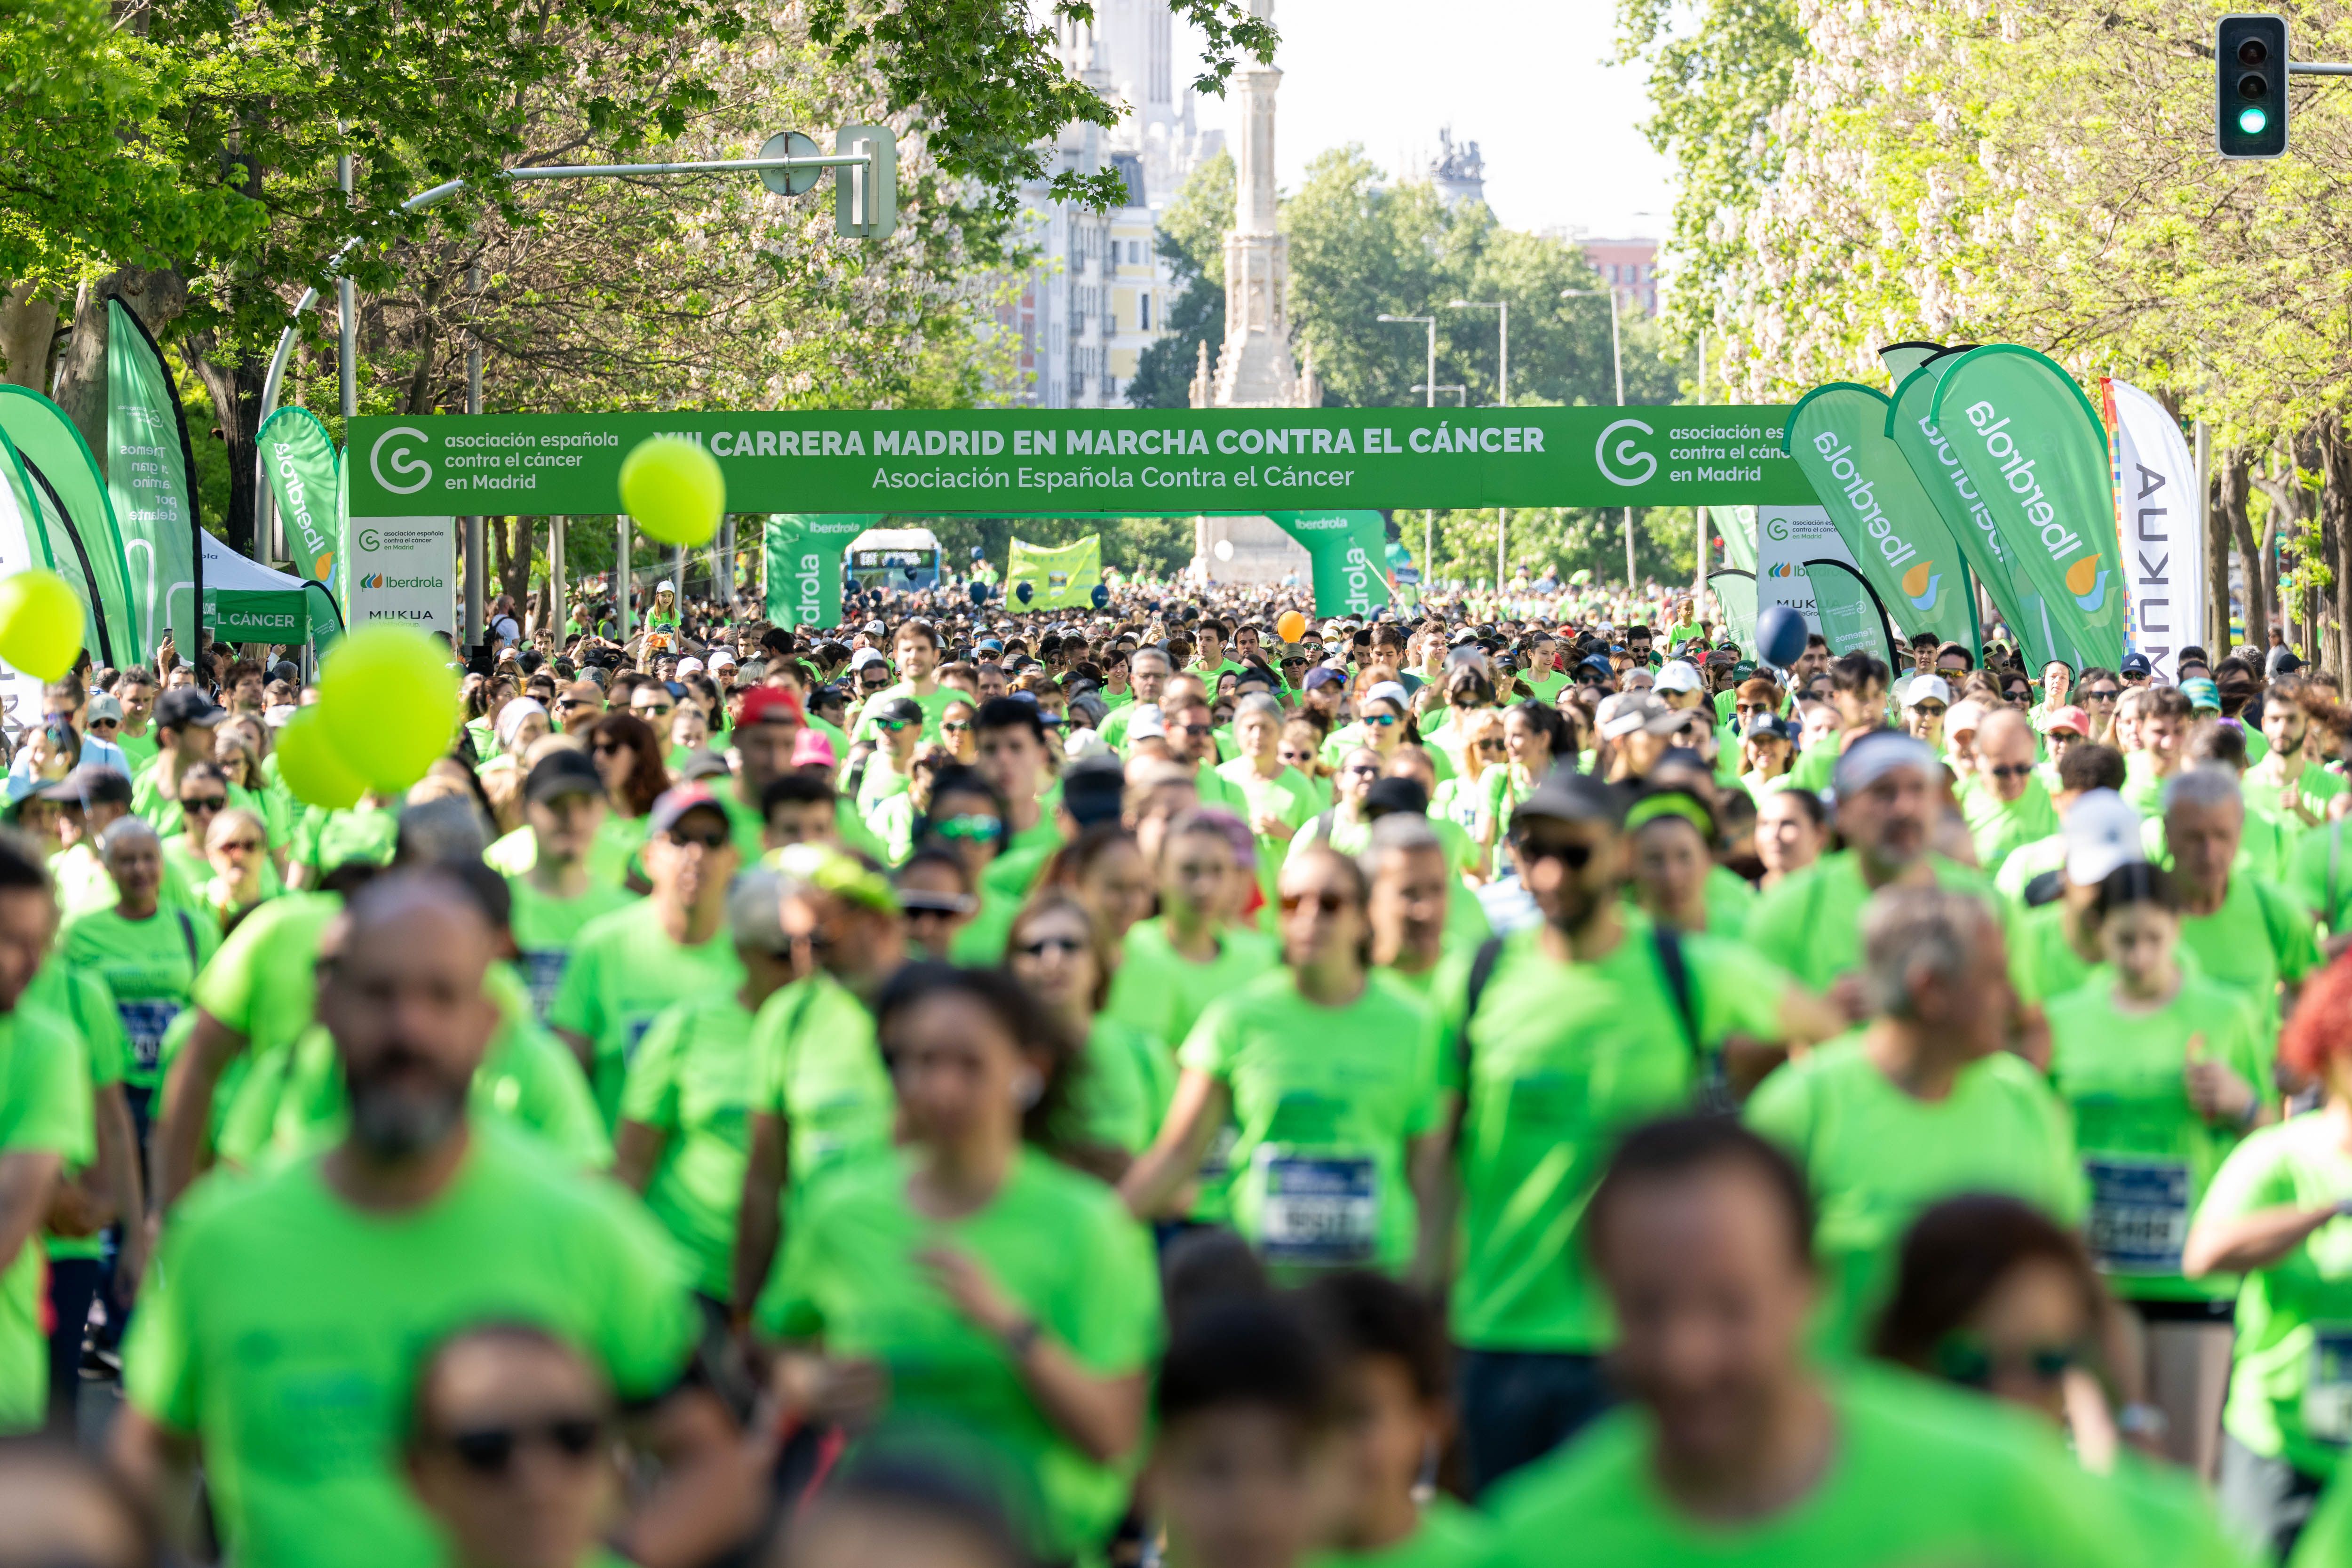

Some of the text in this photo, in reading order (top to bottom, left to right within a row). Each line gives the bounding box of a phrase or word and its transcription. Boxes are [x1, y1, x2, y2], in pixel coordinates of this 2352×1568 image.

[710, 431, 866, 456] CARRERA
[874, 430, 1004, 455] MADRID
[1014, 430, 1056, 455] EN
[1066, 429, 1209, 455] MARCHA
[1216, 428, 1356, 454] CONTRA
[1364, 428, 1402, 454] EL
[1409, 421, 1545, 453] CÁNCER
[1669, 424, 1761, 439] asociación
[445, 431, 618, 451] asociación española
[445, 452, 583, 468] contra el cáncer
[1670, 445, 1725, 460] contra
[1730, 444, 1745, 459] el
[445, 474, 536, 490] en Madrid
[872, 465, 1354, 493] Asociación Española Contra el Cáncer
[1670, 466, 1761, 482] en Madrid
[810, 521, 860, 533] Iberdrola
[1295, 517, 1348, 530] Iberdrola
[386, 576, 443, 588] Iberdrola
[217, 611, 295, 628] L CÁNCER
[369, 610, 433, 620] MUKUA
